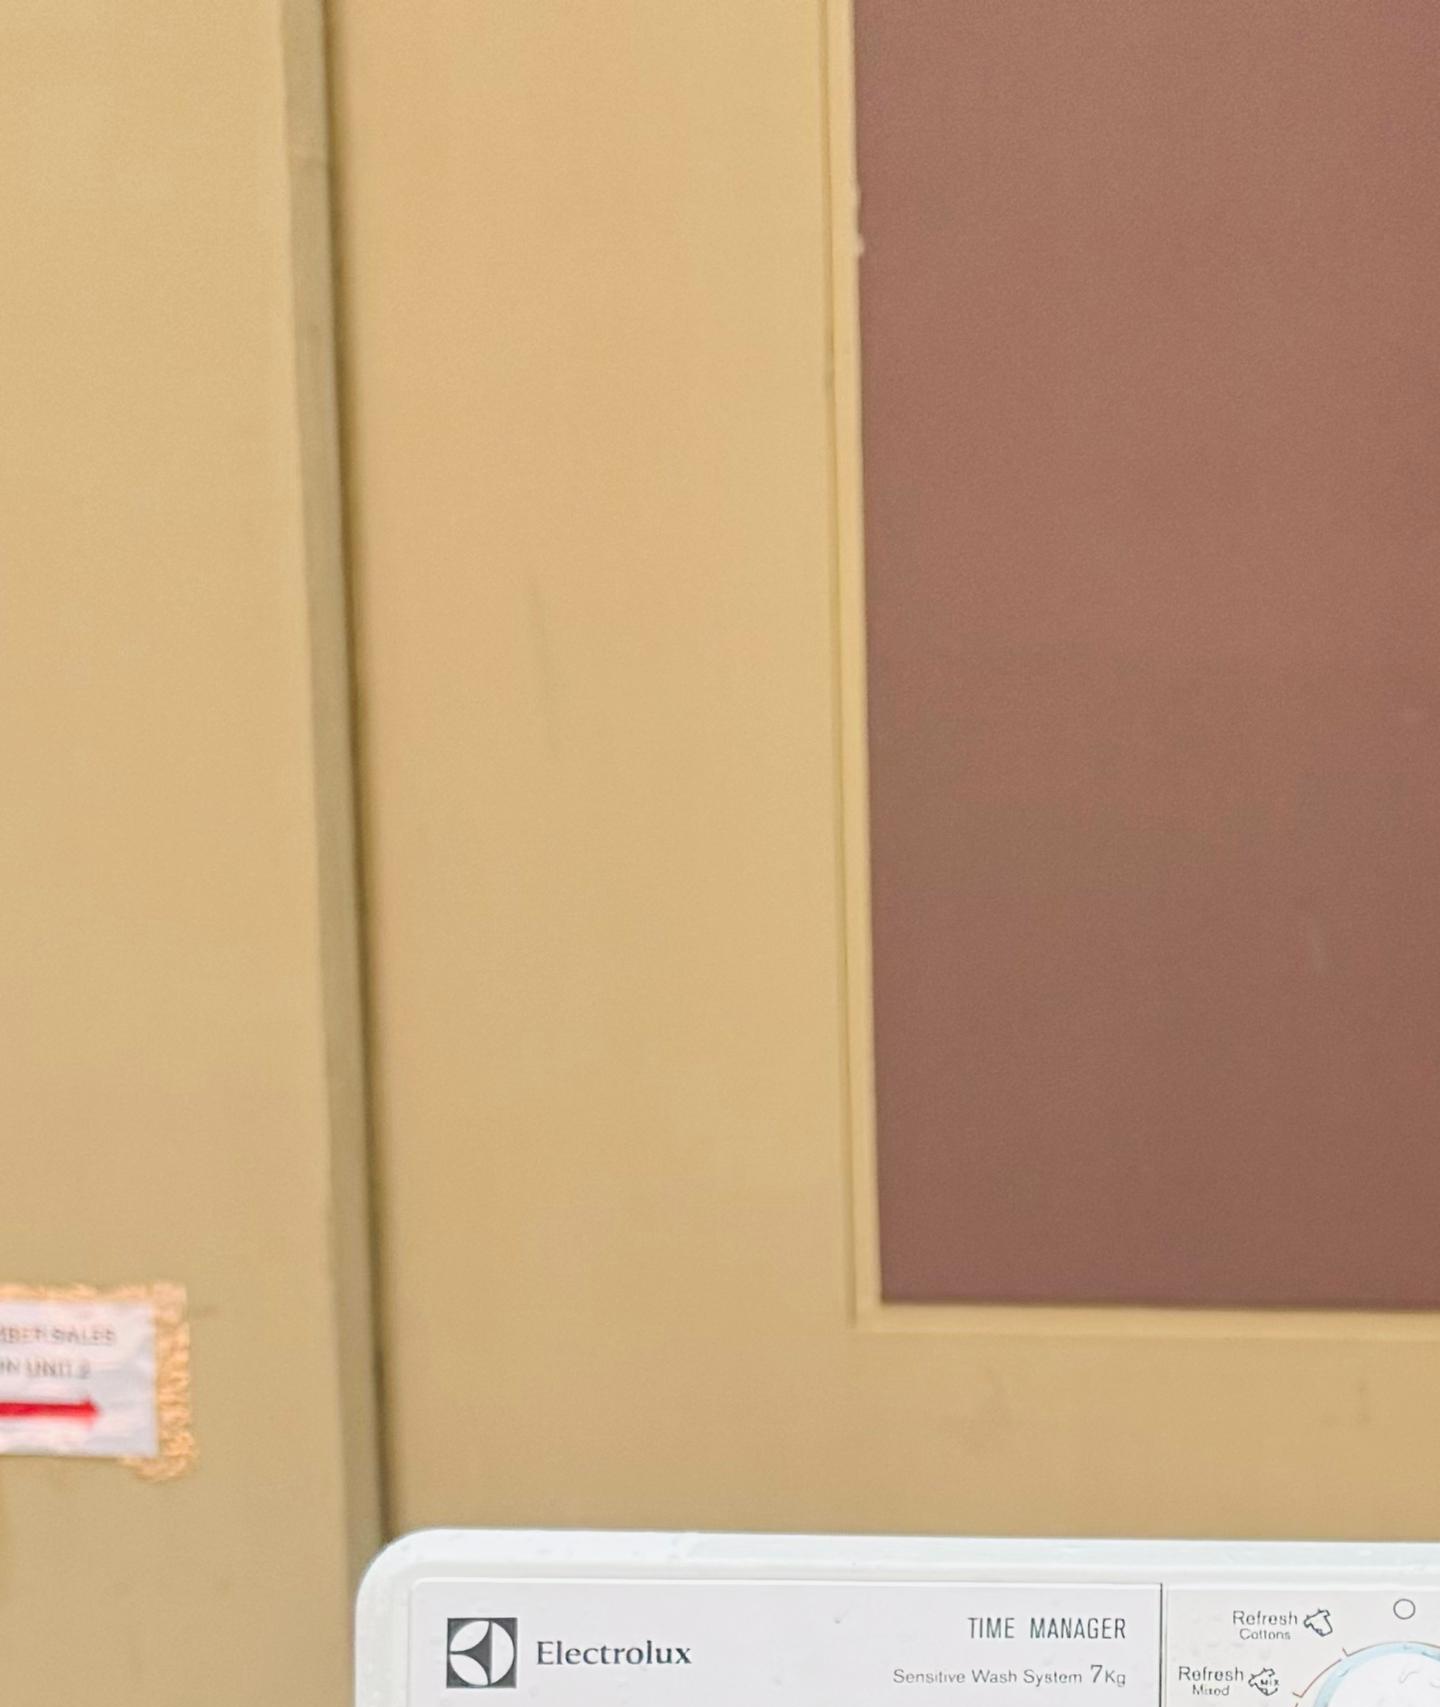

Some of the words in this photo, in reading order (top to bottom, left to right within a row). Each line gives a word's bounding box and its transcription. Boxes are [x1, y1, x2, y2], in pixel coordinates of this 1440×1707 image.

[1233, 1610, 1298, 1625] Refresh
[968, 1617, 1015, 1639] TIME
[1030, 1617, 1126, 1639] MANAGER
[1239, 1628, 1291, 1640] Cottons
[536, 1640, 692, 1665] Electrolux
[893, 1669, 965, 1684] Sensitive
[971, 1669, 1017, 1684] Wash
[1023, 1669, 1082, 1687] System
[1178, 1666, 1244, 1681] Refresh
